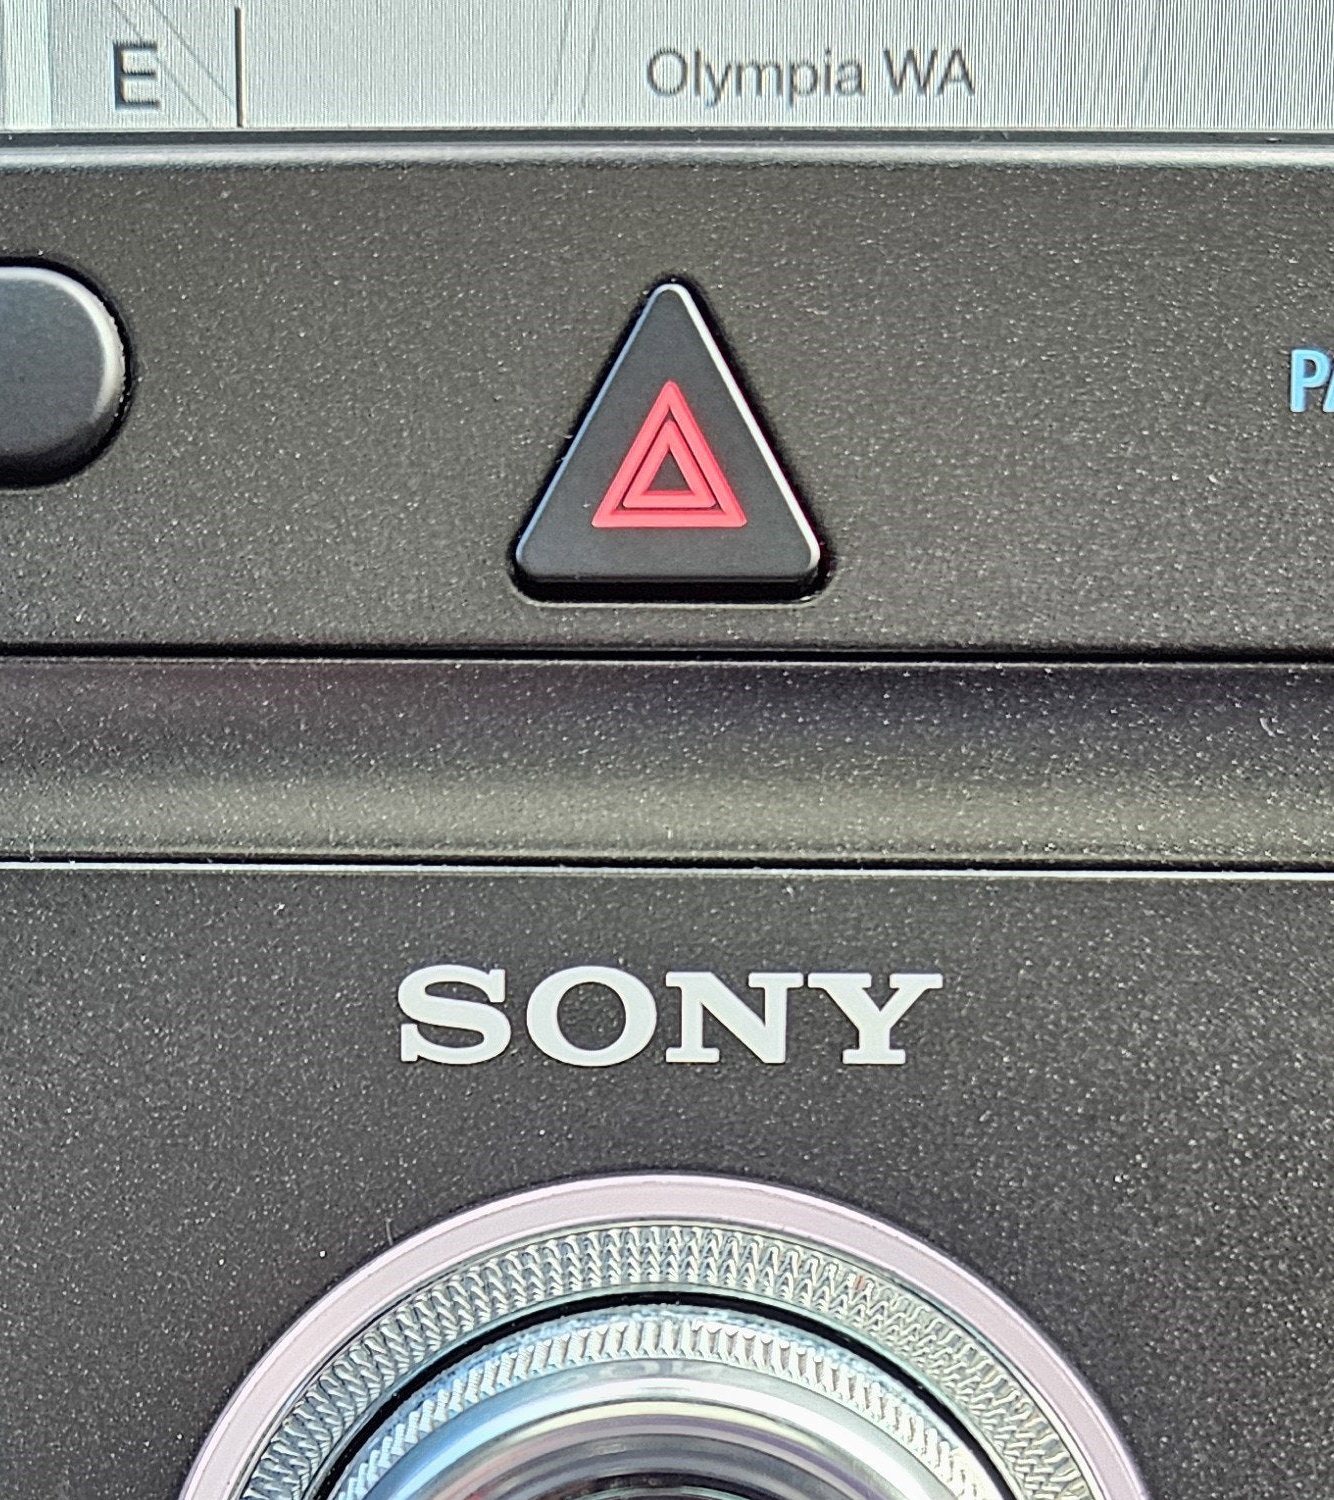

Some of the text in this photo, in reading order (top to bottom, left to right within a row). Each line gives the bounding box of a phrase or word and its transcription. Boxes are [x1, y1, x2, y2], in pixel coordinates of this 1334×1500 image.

[114, 41, 159, 109] E
[646, 47, 975, 108] Olympia WA
[397, 964, 944, 1067] SONY
